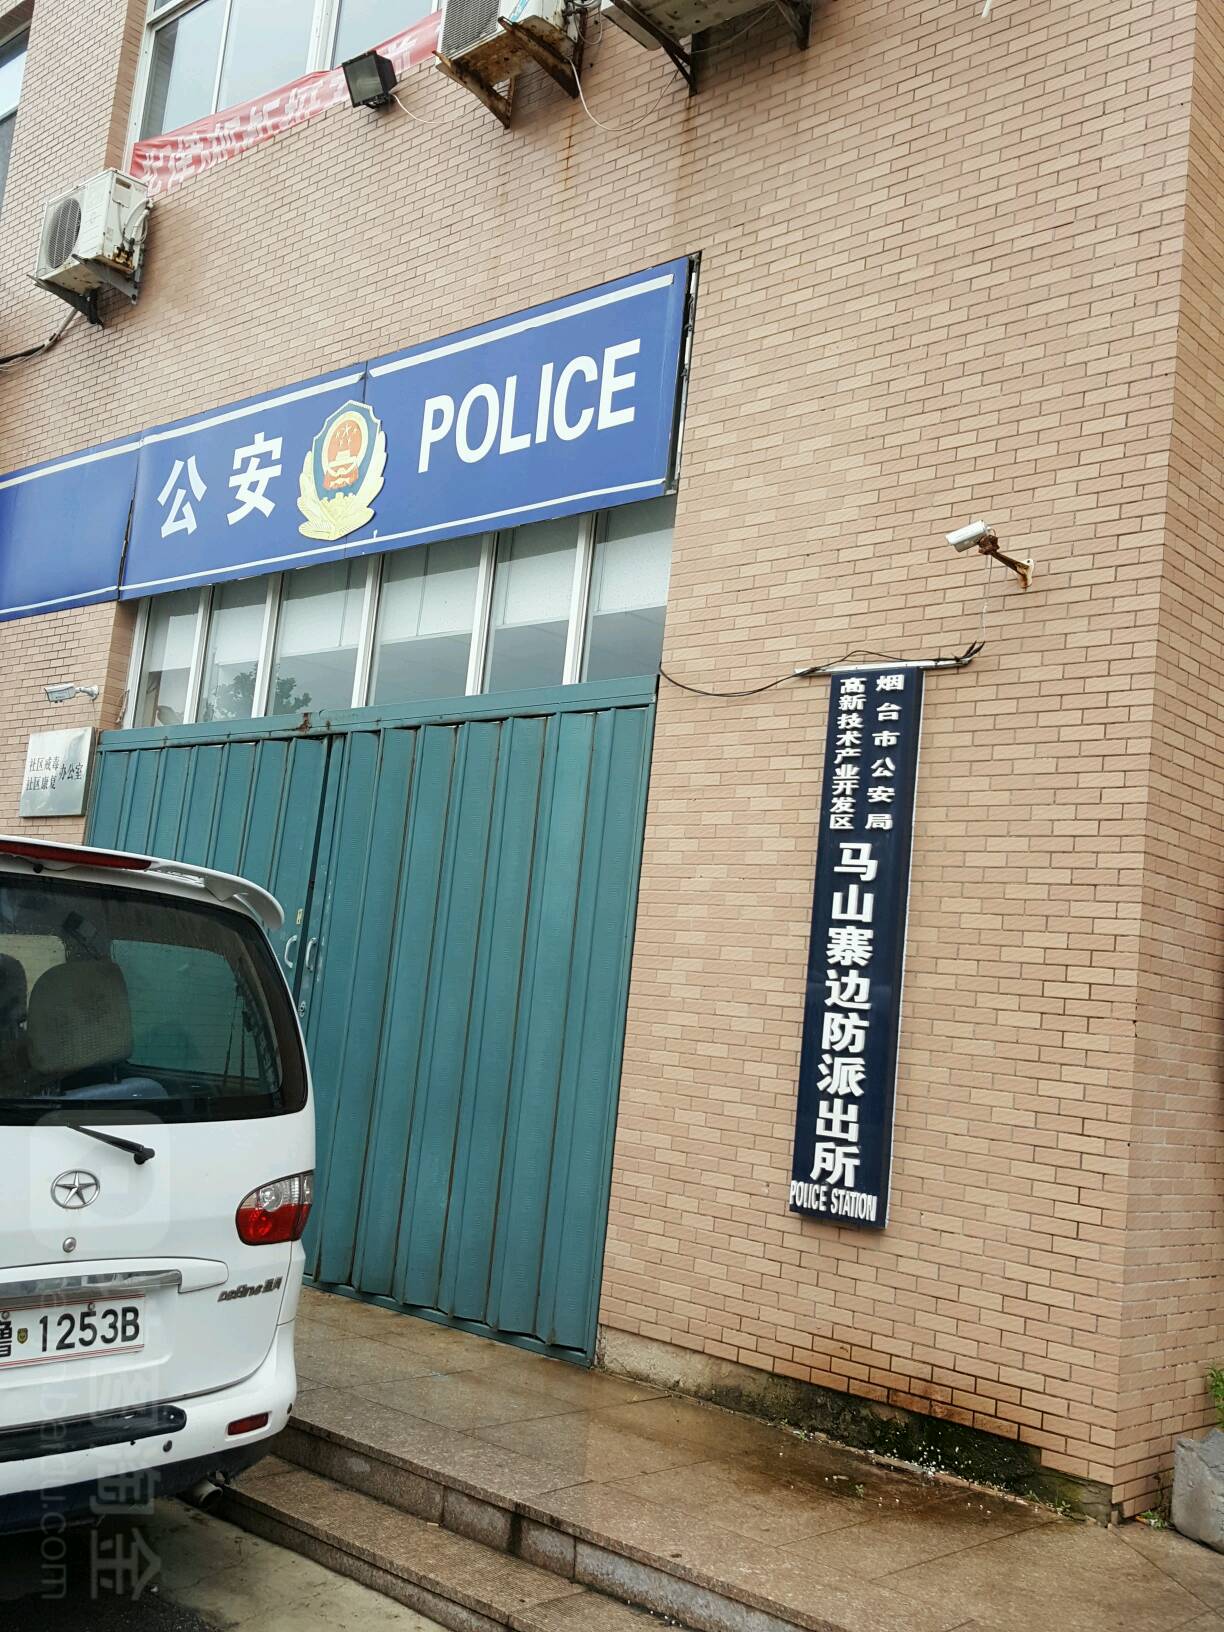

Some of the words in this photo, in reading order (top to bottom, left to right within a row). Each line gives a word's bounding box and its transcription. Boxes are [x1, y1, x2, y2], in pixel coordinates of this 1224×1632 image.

[157, 432, 284, 539] 公安
[418, 338, 642, 473] POLICE
[829, 677, 867, 831] 高新技术产业开发区
[865, 674, 905, 831] 烟台市公安局
[810, 842, 879, 1188] 马山寨边防派出所
[789, 1180, 828, 1212] POLICE
[830, 1187, 878, 1222] STATION
[39, 1306, 140, 1353] 1253B
